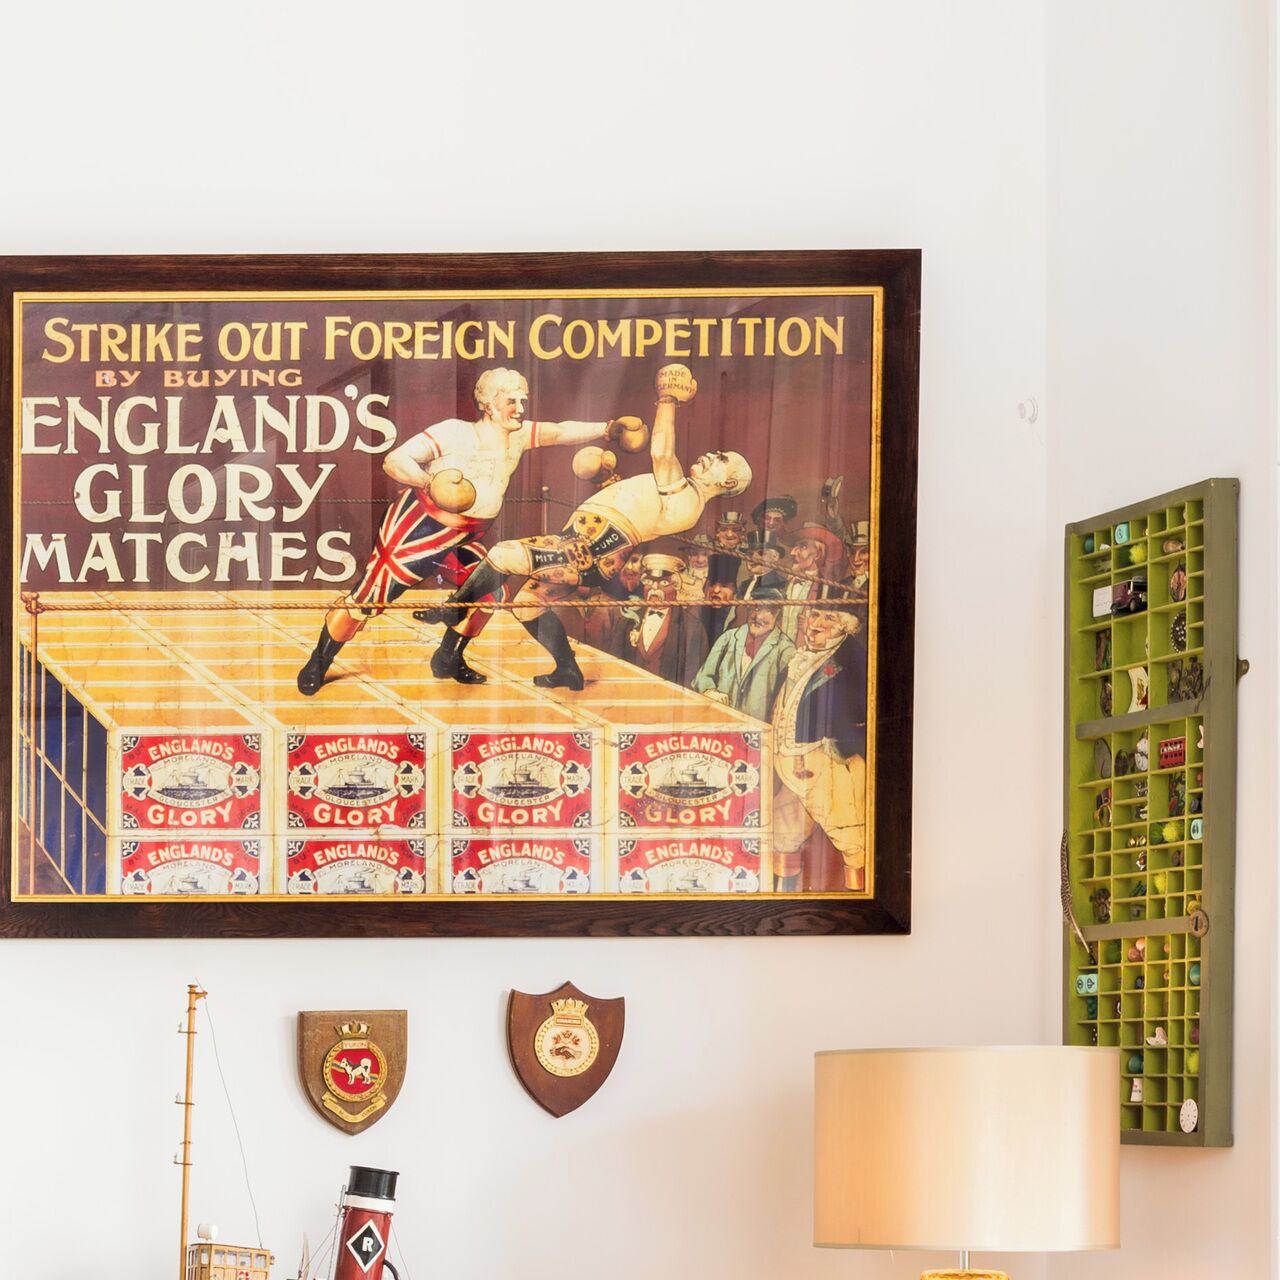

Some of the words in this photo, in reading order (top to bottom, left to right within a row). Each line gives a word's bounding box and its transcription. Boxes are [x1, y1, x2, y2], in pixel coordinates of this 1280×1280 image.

[42, 316, 204, 363] STRIKE
[217, 321, 308, 363] OUT
[324, 315, 516, 361] FOREIGN
[528, 313, 846, 361] COMPETITION
[95, 369, 141, 388] BY
[163, 368, 303, 388] BUYING
[21, 383, 398, 455] ENGLAND'S
[73, 463, 338, 524] GLORY
[600, 533, 619, 550] UND
[20, 530, 358, 584] MATCHES
[535, 553, 555, 563] MIT
[147, 738, 235, 761] ENGLAND'S
[314, 738, 400, 759] ENGLAND'S
[330, 754, 383, 764] MORELAND
[477, 736, 566, 759] ENGLAND'S
[644, 736, 734, 759] ENGLAND'S
[147, 800, 233, 827] GLORY
[313, 799, 399, 826] GLORY
[477, 799, 563, 825] GLORY
[645, 799, 732, 824] GLORY
[147, 844, 235, 866] ENGLAND'S
[313, 843, 400, 866] ENGLAND'S
[329, 860, 382, 870] MORELAND
[477, 842, 566, 865] ENGLAND'S
[644, 842, 735, 865] ENGLAND'S
[362, 1236, 374, 1252] R
